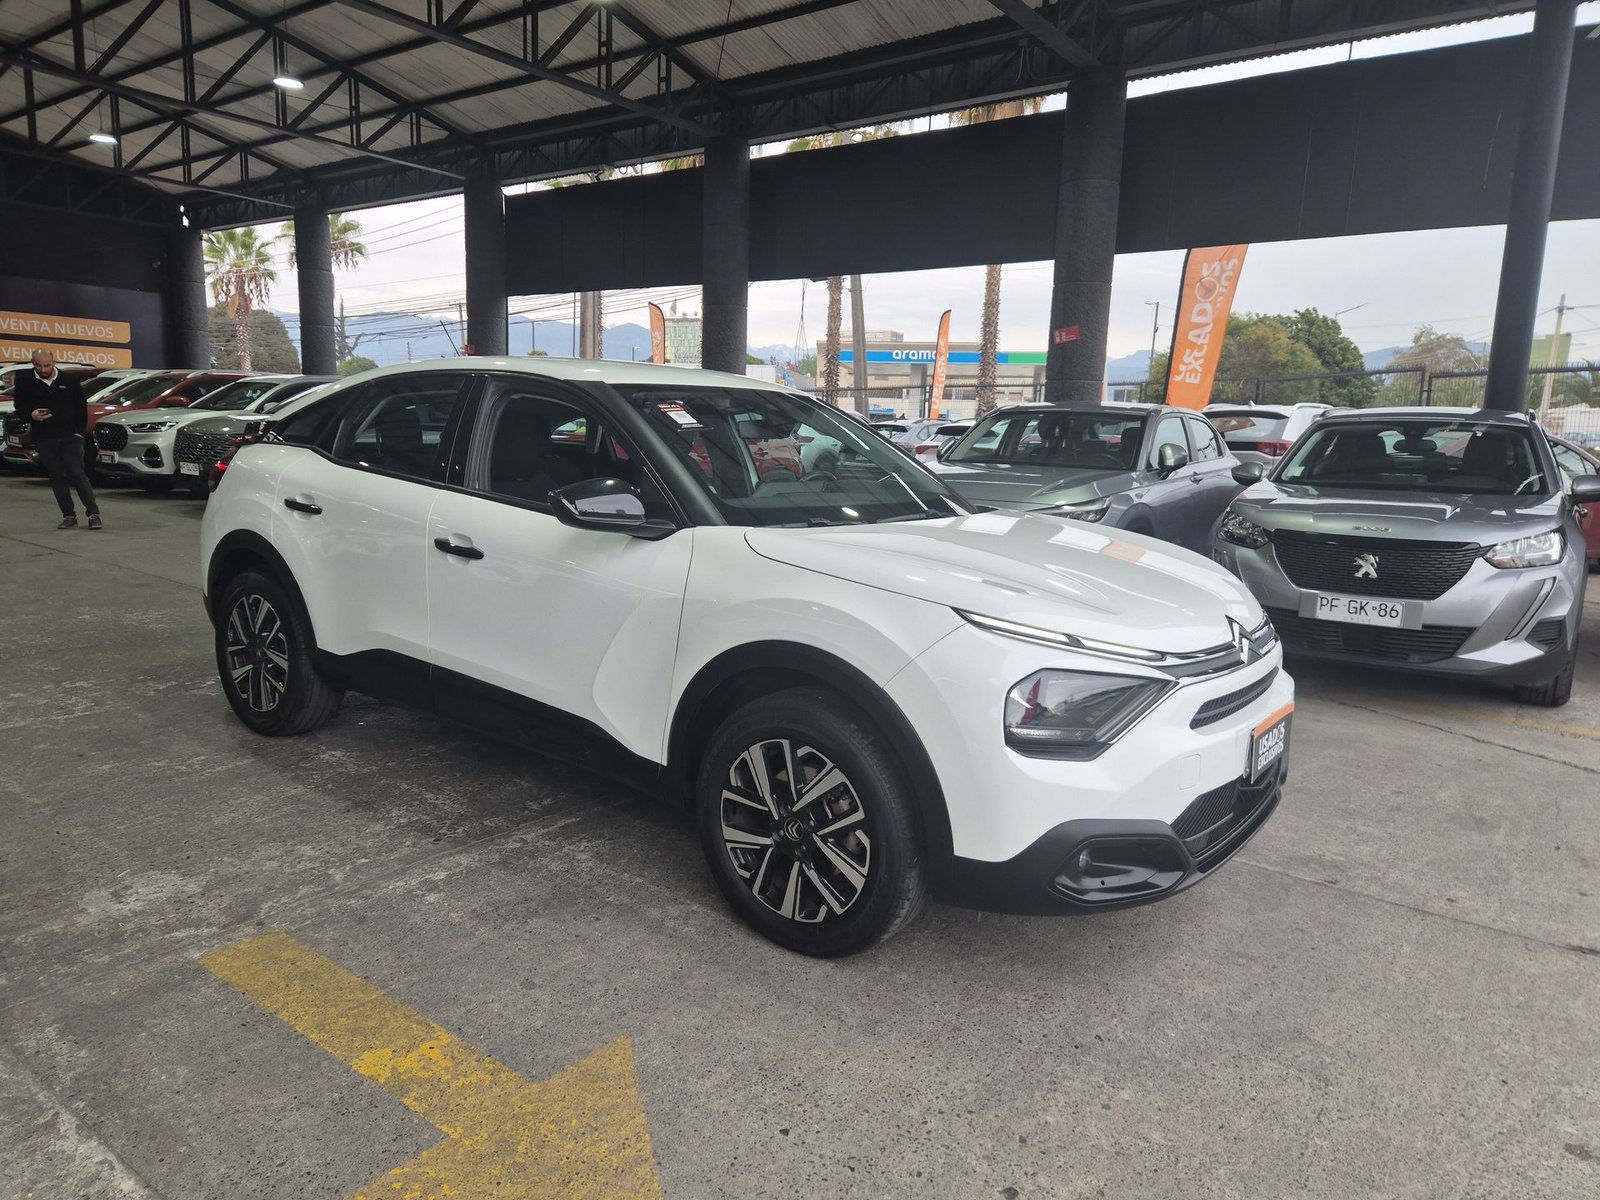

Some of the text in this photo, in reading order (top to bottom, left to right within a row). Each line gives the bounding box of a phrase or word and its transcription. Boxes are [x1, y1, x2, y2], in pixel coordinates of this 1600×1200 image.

[0, 317, 114, 338] VENTA NUEVOS
[56, 351, 116, 365] USADOS
[892, 350, 949, 360] aramc
[1259, 720, 1285, 756] USADOS
